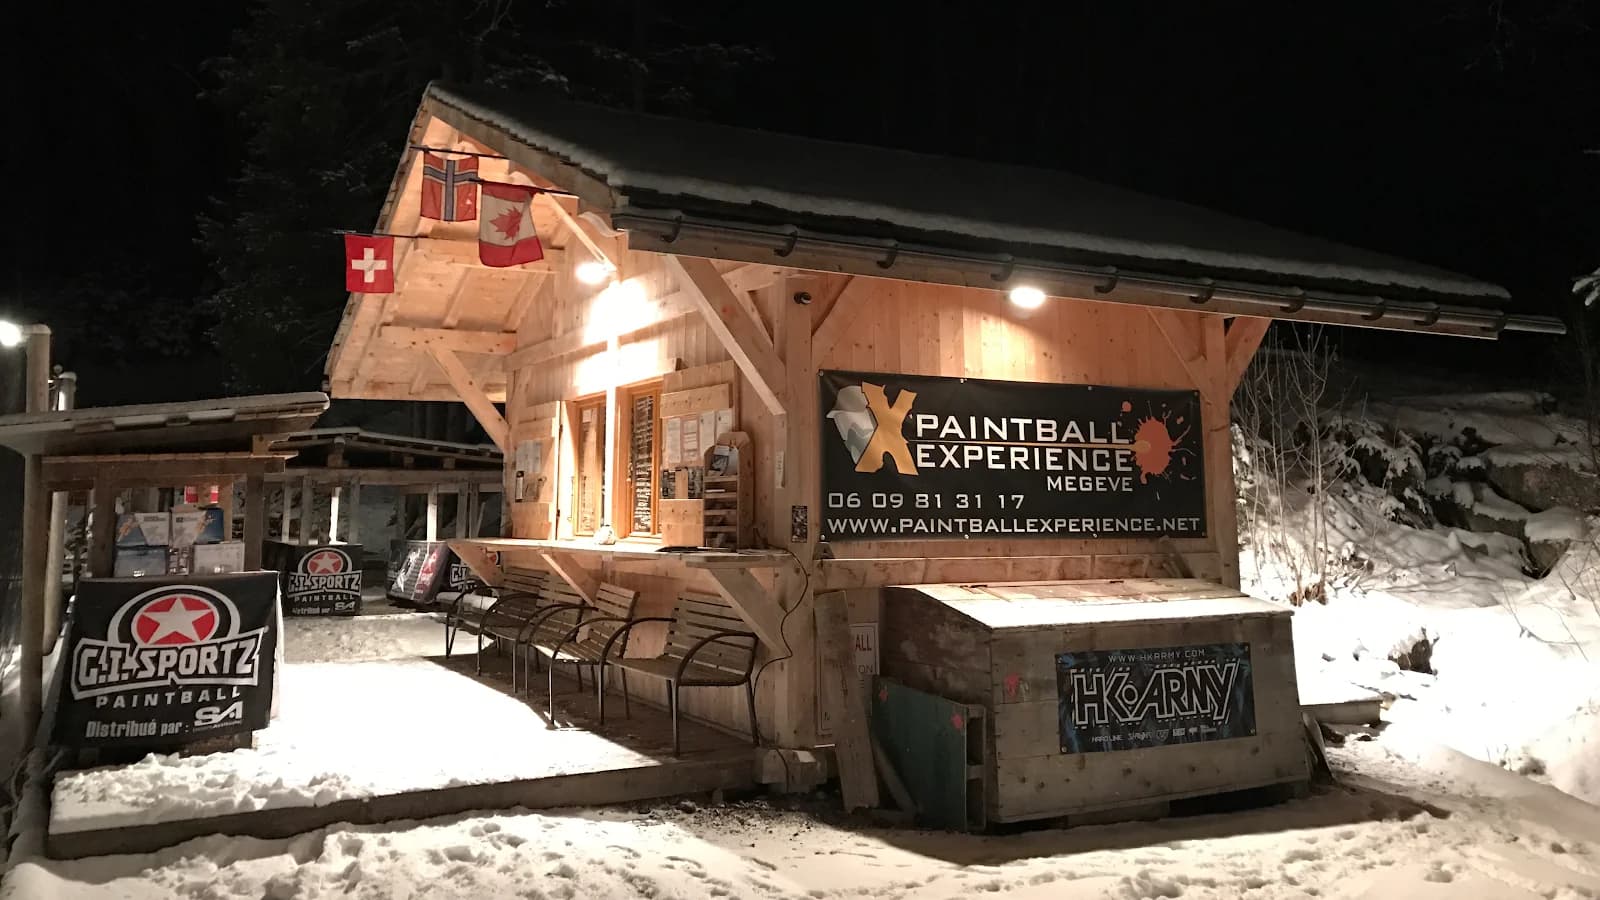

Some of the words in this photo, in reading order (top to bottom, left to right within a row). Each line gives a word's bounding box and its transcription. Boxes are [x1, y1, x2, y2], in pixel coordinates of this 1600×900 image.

[916, 413, 1134, 444] PAINTBALL
[916, 443, 1134, 472] EXPERIENCE
[1046, 475, 1134, 493] MEGEVE
[828, 493, 861, 509] 06
[872, 493, 904, 509] 09
[915, 493, 942, 509] 81
[956, 494, 982, 509] 31
[1000, 494, 1025, 509] 17
[827, 516, 1201, 534] WWW.PAINTBALLEXPERIENCE.NET
[97, 686, 241, 708] PAINTBALL
[85, 719, 157, 738] Distribué
